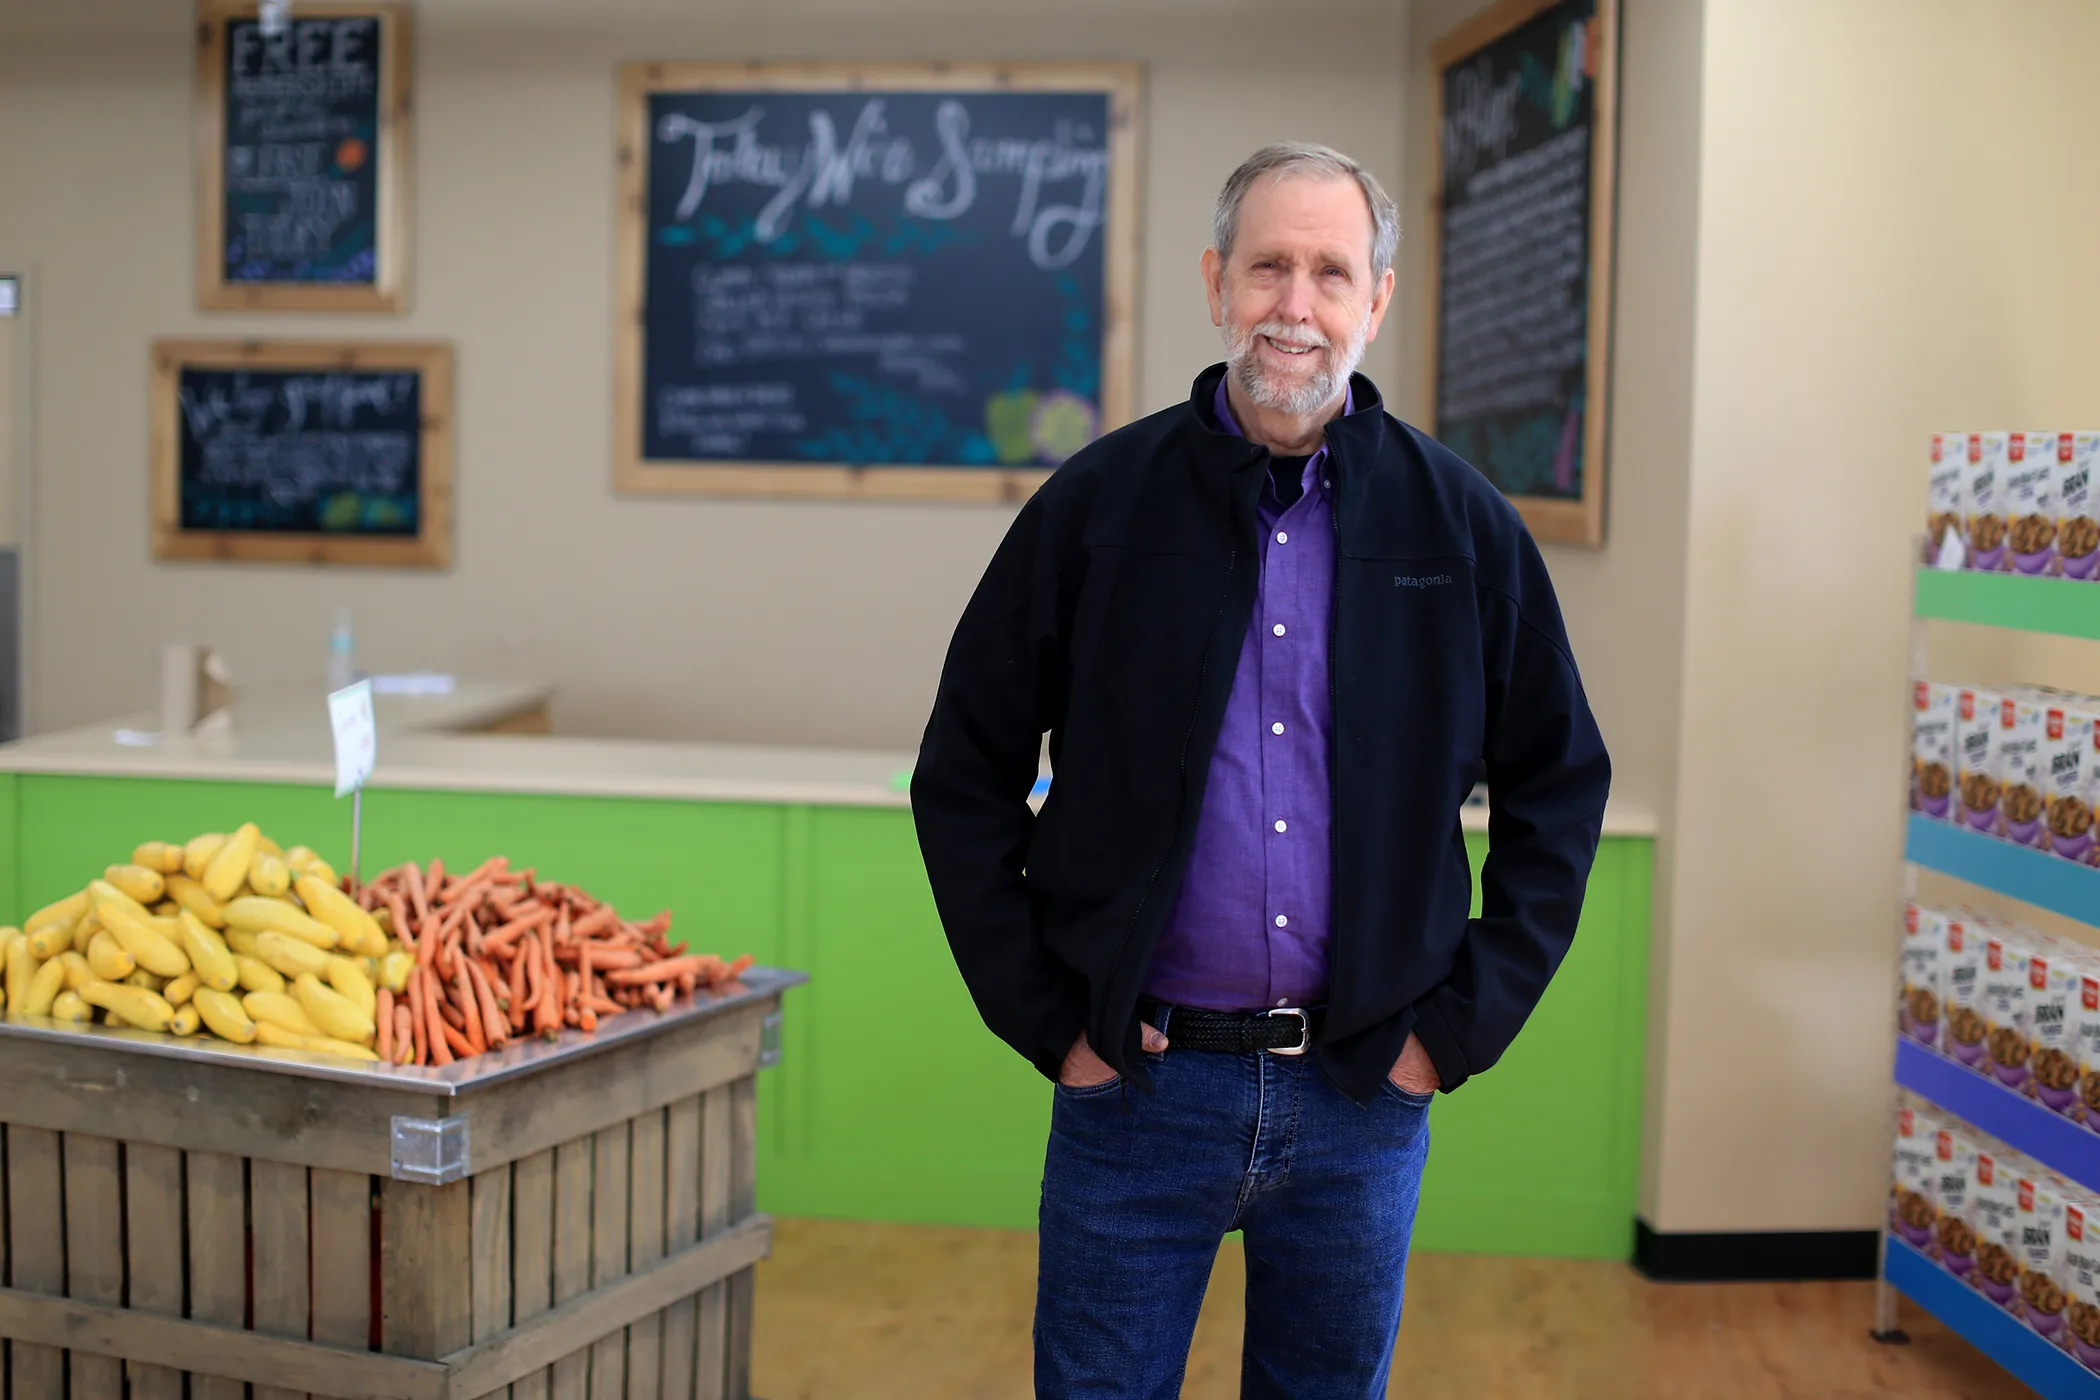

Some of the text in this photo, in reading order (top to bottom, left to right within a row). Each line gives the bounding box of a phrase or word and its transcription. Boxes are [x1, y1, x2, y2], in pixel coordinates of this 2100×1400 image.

[232, 19, 372, 76] FREE
[2061, 468, 2089, 498] BRAN
[1394, 574, 1452, 589] patagonia
[2051, 750, 2080, 774] BRAN
[2034, 1003, 2065, 1024] BRAN
[2023, 1226, 2051, 1246] BRAN
